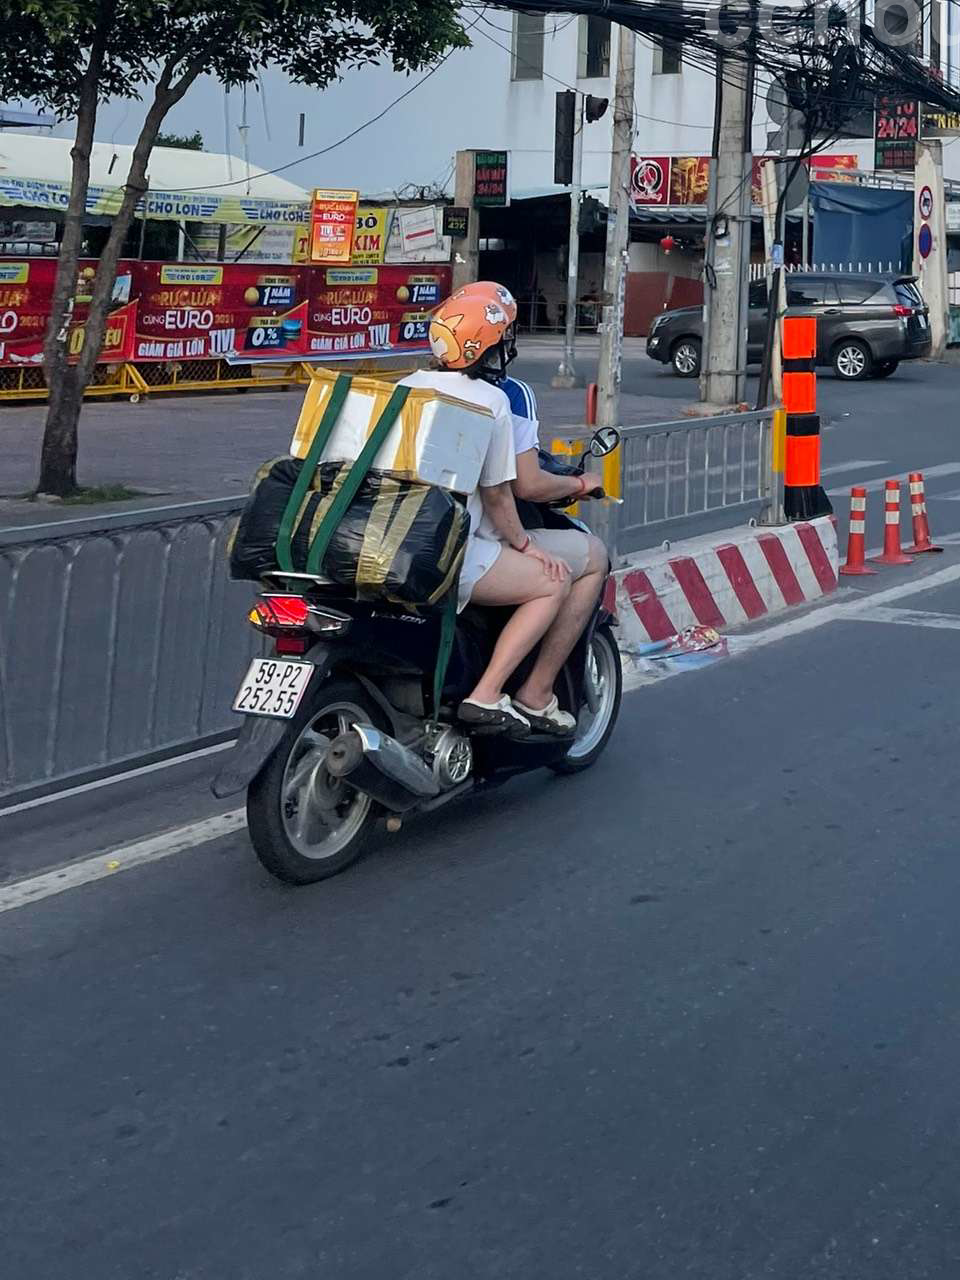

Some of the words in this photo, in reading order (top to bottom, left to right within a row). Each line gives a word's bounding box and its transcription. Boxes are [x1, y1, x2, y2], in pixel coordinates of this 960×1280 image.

[878, 116, 917, 139] 24/24
[323, 213, 345, 221] EURO
[263, 286, 271, 305] 1
[413, 286, 419, 302] 1
[165, 309, 213, 329] EURO
[332, 307, 371, 326] EURO
[209, 328, 235, 354] TIVI
[238, 686, 299, 715] 252.55
